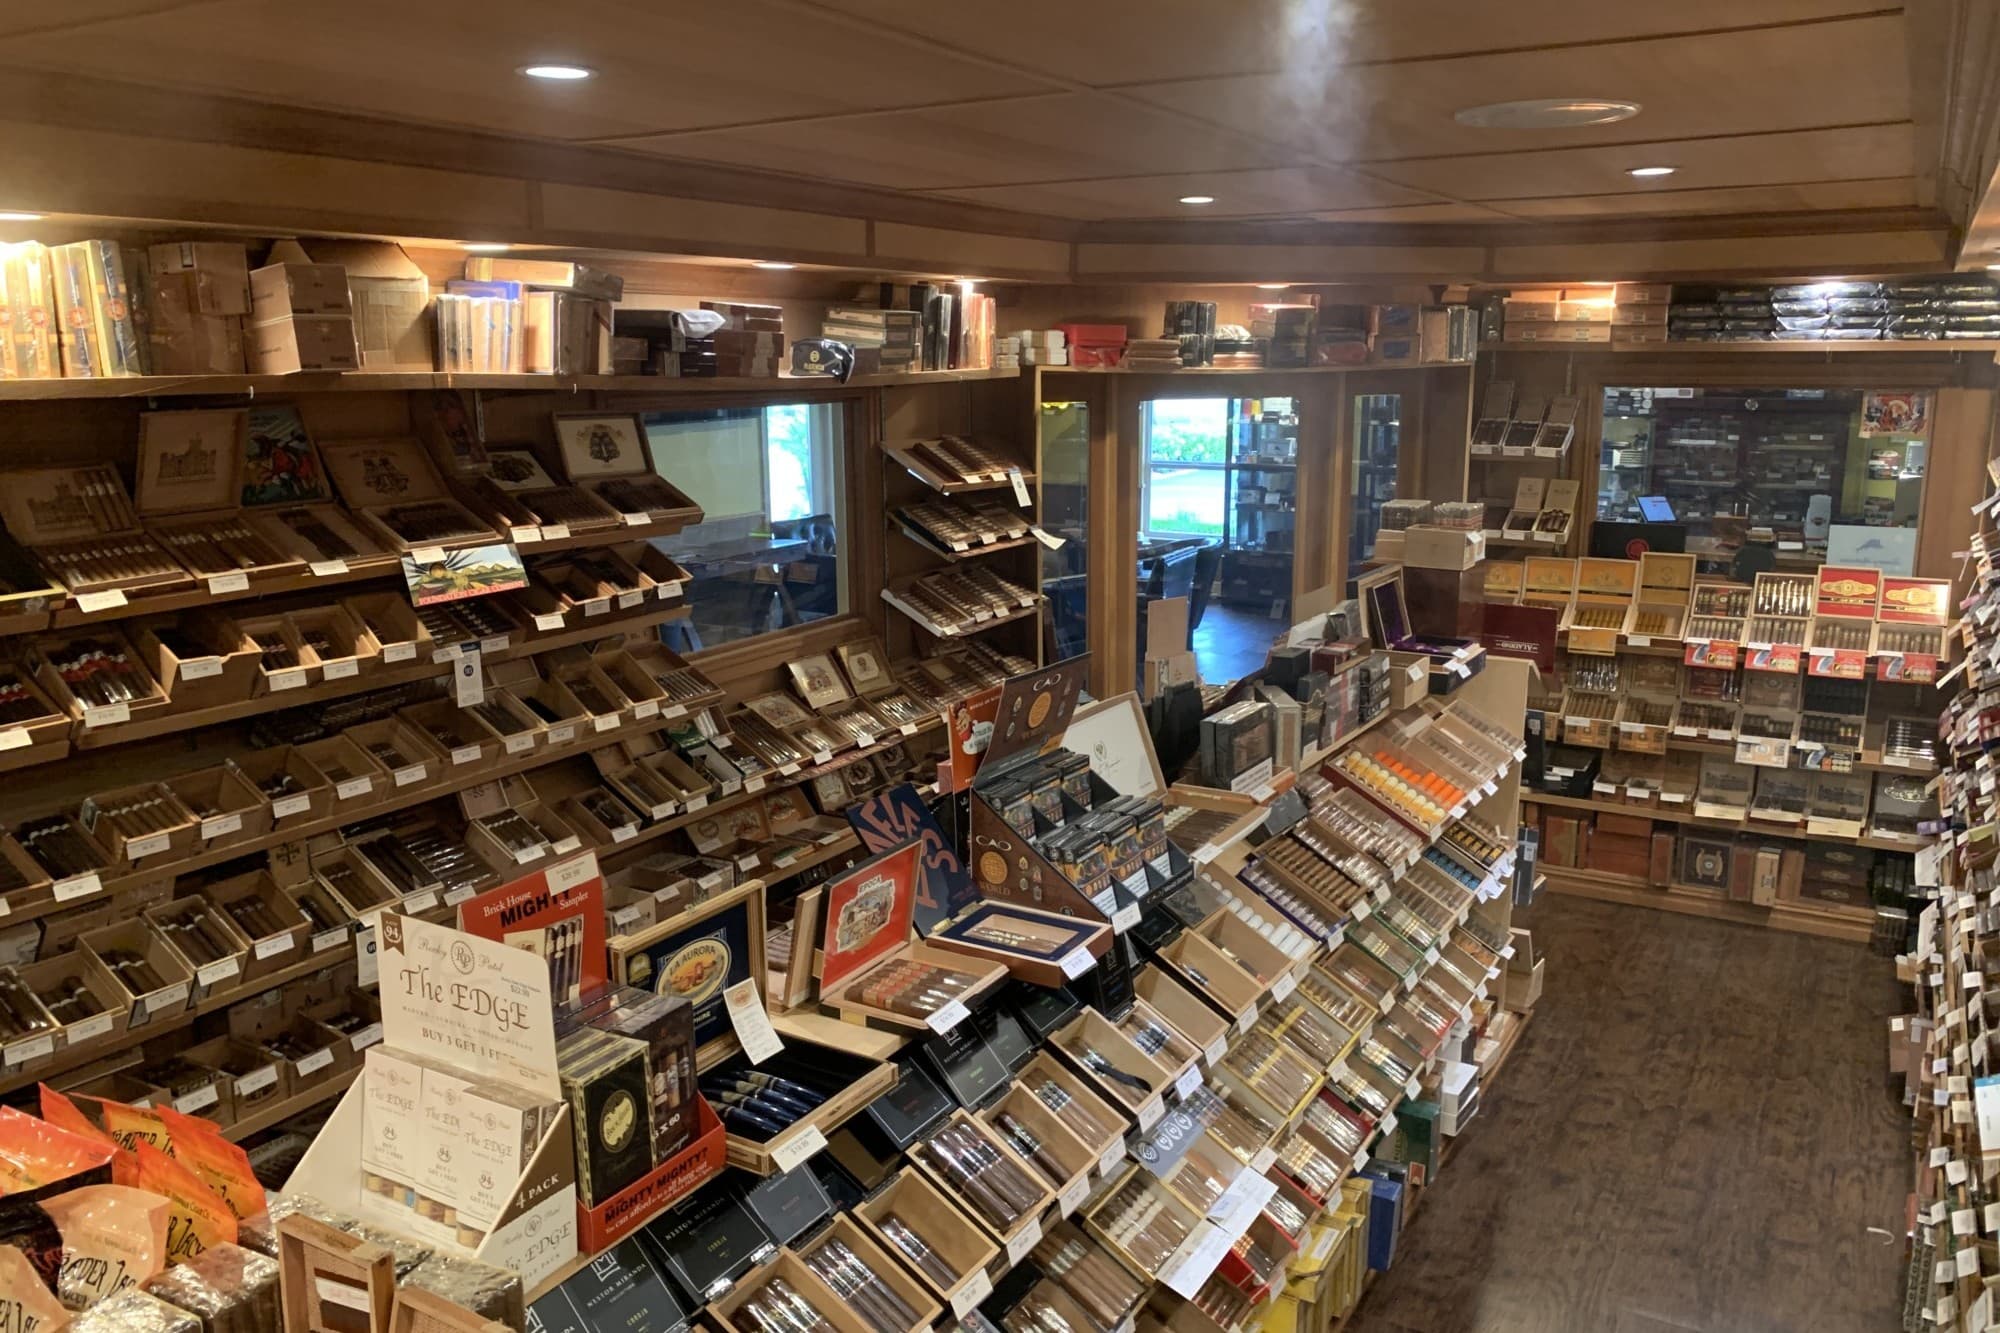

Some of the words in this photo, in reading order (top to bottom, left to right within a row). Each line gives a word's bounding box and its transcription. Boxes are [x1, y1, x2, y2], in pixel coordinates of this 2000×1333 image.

[1033, 673, 1062, 692] CAO
[975, 834, 1012, 851] CAO
[483, 900, 505, 917] Brick
[506, 891, 532, 908] House
[559, 891, 589, 911] Sampler
[385, 926, 399, 940] 94
[668, 961, 681, 977] LA
[681, 944, 716, 964] AURORA
[400, 964, 444, 1004] The
[450, 983, 530, 1033] EDGE
[422, 1027, 444, 1043] BUY
[455, 1038, 476, 1054] GET
[483, 1138, 513, 1158] EDGE
[514, 1191, 527, 1209] 4
[529, 1173, 560, 1200] PACK
[604, 1182, 654, 1225] MIGHTY
[525, 1220, 572, 1264] EDGE
[665, 1219, 693, 1241] NESTOR
[586, 1285, 614, 1308] NESTOR
[615, 1261, 647, 1288] MIRANDA
